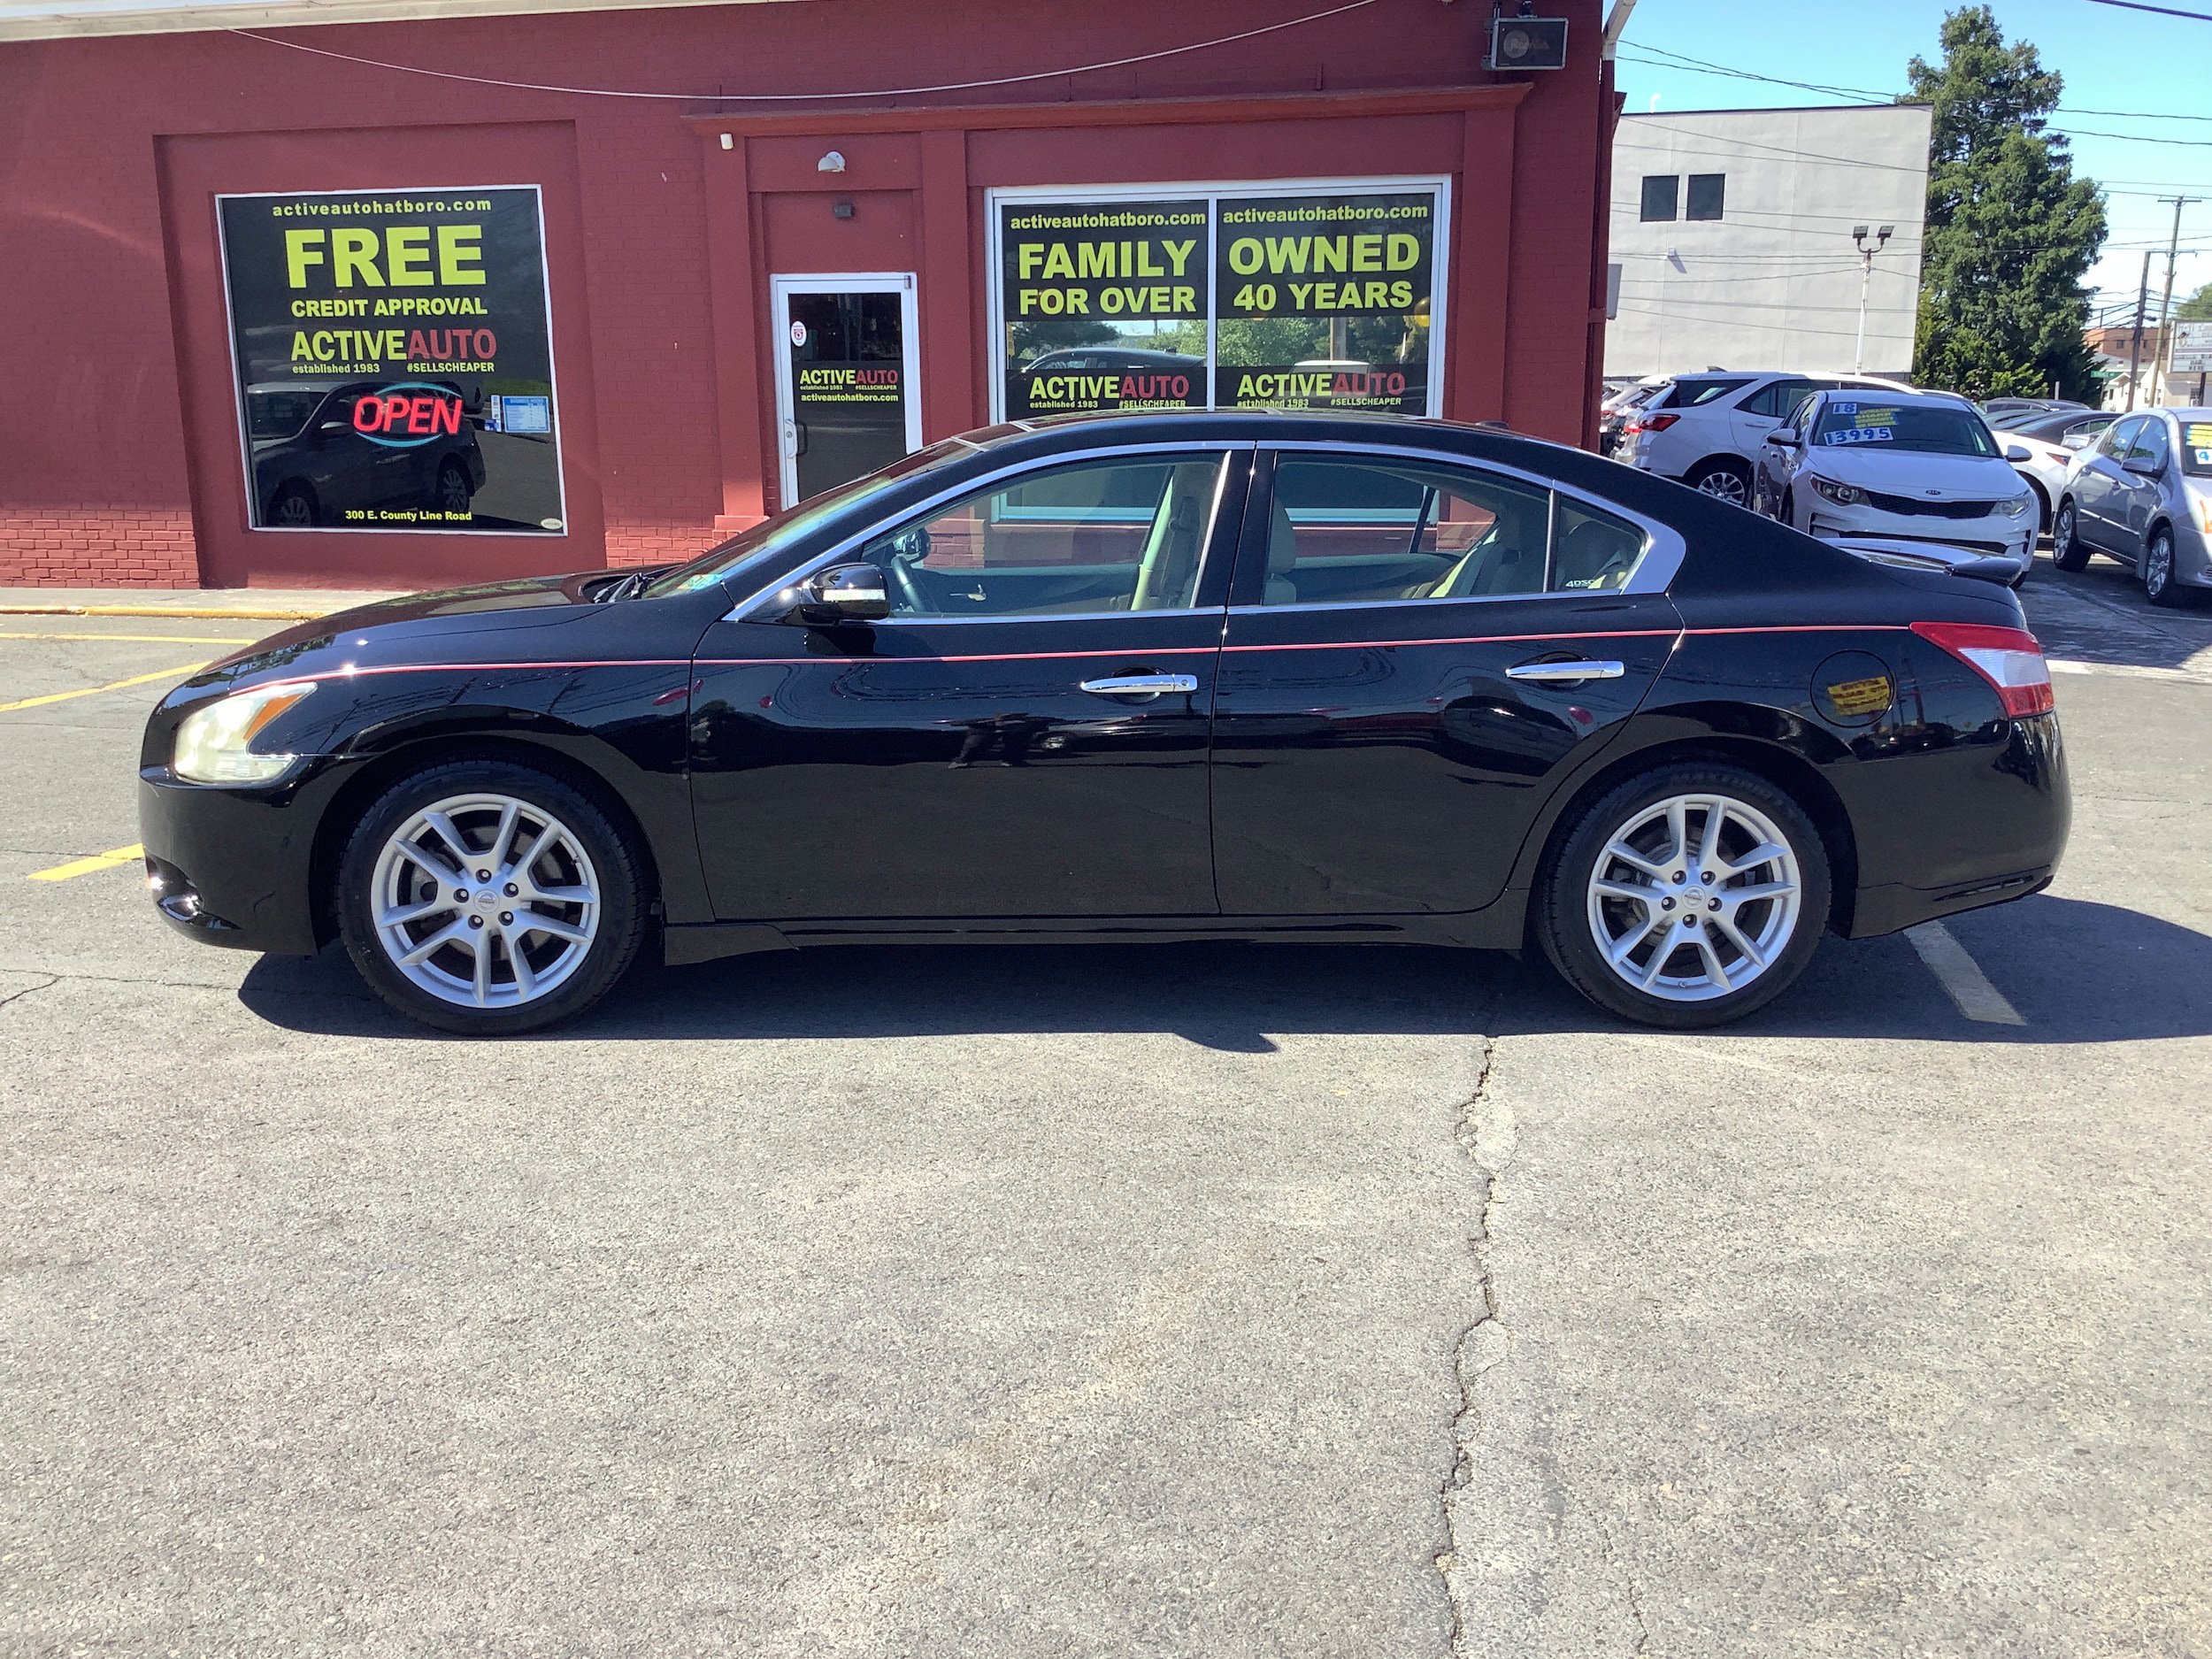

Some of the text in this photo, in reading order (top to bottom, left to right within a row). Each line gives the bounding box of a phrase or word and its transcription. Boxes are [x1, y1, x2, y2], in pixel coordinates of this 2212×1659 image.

[273, 200, 491, 217] activeautohatboro.com
[1223, 204, 1427, 223] activeautohatboro.com
[1010, 212, 1206, 229] activeautohatboro.com
[285, 225, 487, 288] FREE
[1018, 240, 1197, 280] FAMILY
[1229, 233, 1420, 275] OWNED
[1019, 286, 1196, 315] FOR OVER
[1233, 280, 1413, 311] 40 YEARS
[291, 297, 488, 318] CREDIT APPROVAL
[293, 362, 495, 374] established 1983 #SELLSCHEAPER
[801, 394, 899, 403] activeautohatboro.com
[1030, 399, 1187, 410] established 1983 #SELLSCHEAPER
[1287, 398, 1309, 408] 1983
[1331, 397, 1402, 406] #SELLSCHEAPER
[352, 395, 464, 435] OPEN
[1834, 403, 1855, 413] 18
[1825, 428, 1891, 445] 13995
[346, 510, 472, 522] 300 E. County Line Road
